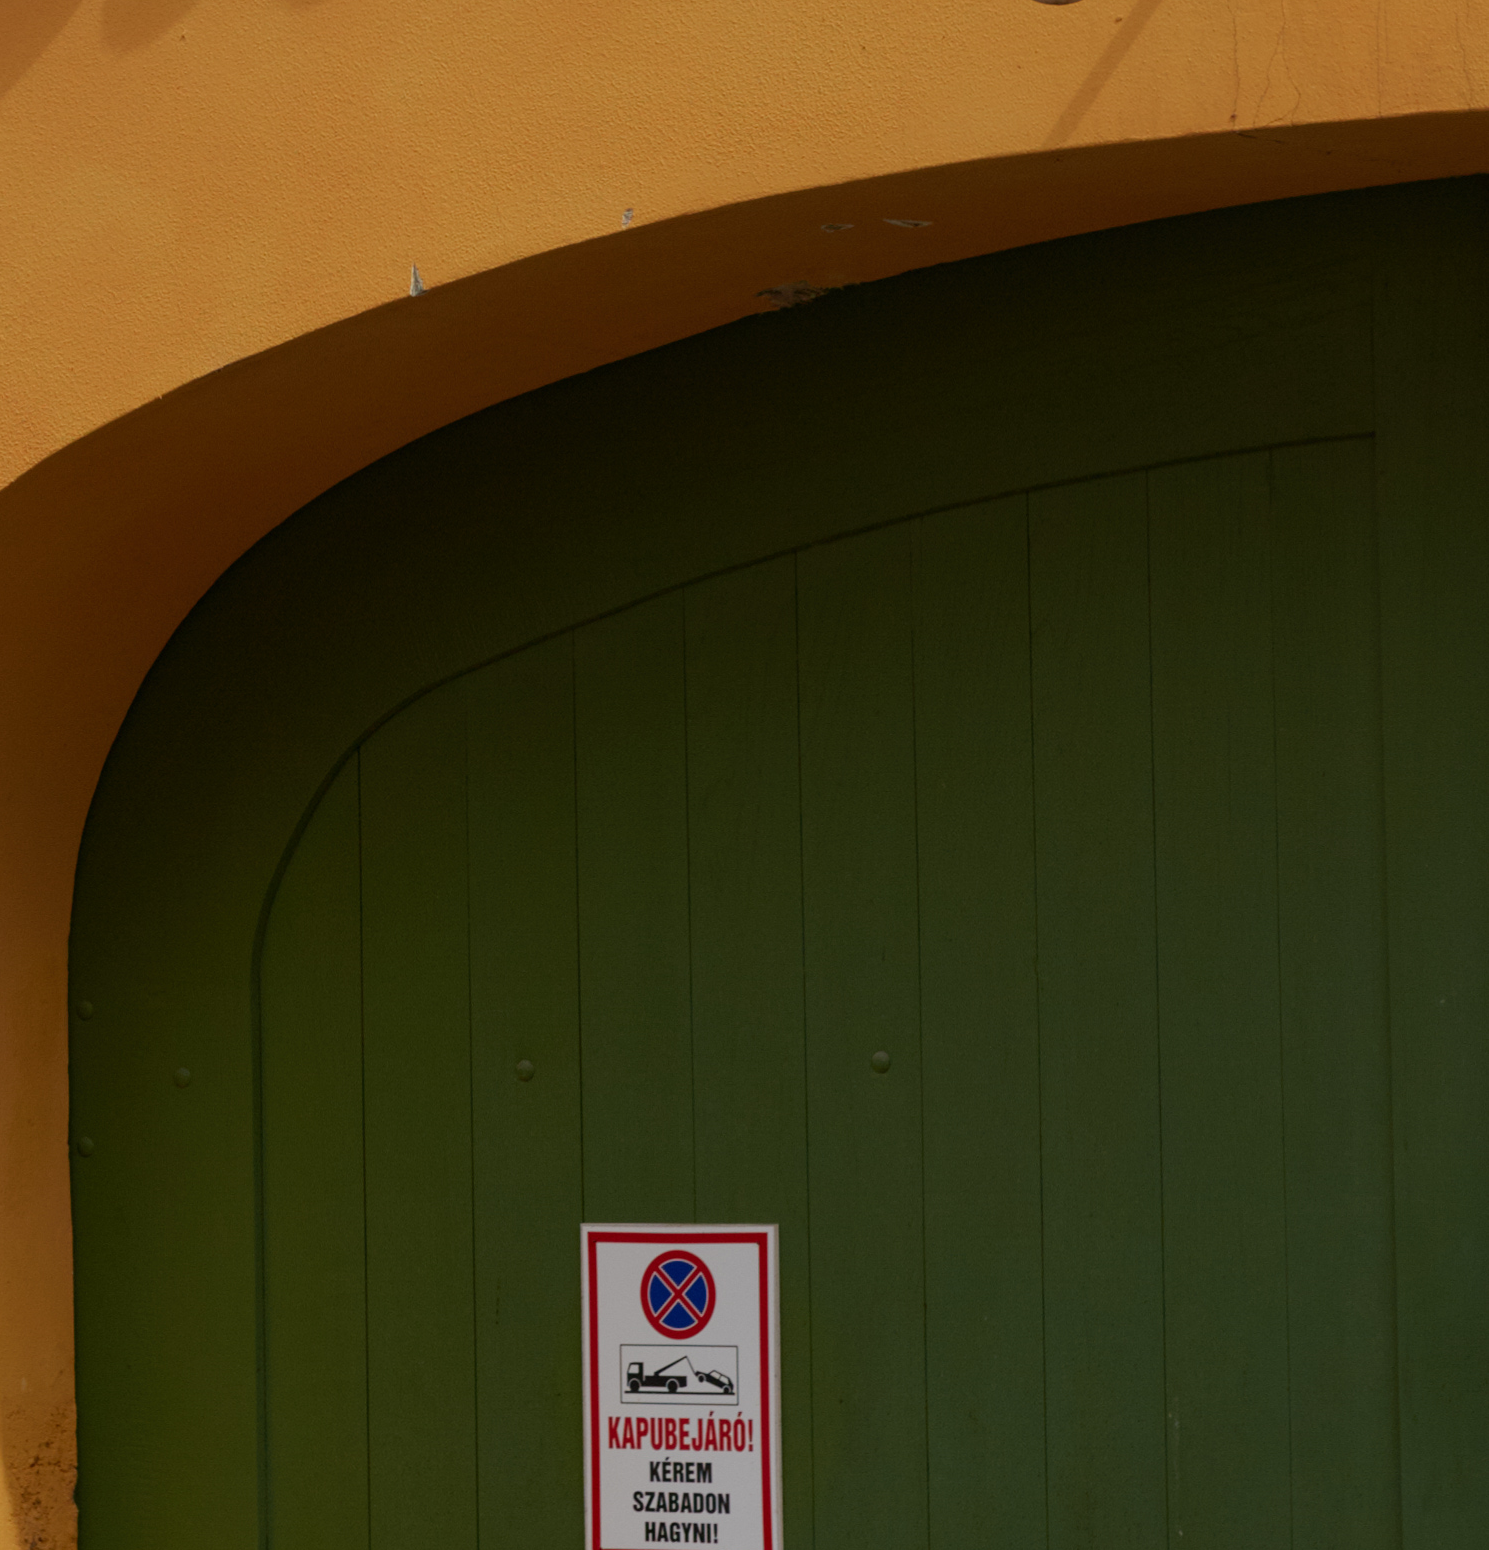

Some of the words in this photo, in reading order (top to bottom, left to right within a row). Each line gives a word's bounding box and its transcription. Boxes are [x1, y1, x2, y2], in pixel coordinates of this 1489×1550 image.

[608, 1410, 754, 1452] KAPUBEJÁRÓ!
[649, 1456, 713, 1484] KÉREM
[632, 1490, 731, 1515] SZABADON
[645, 1521, 719, 1545] HAGYNI!
